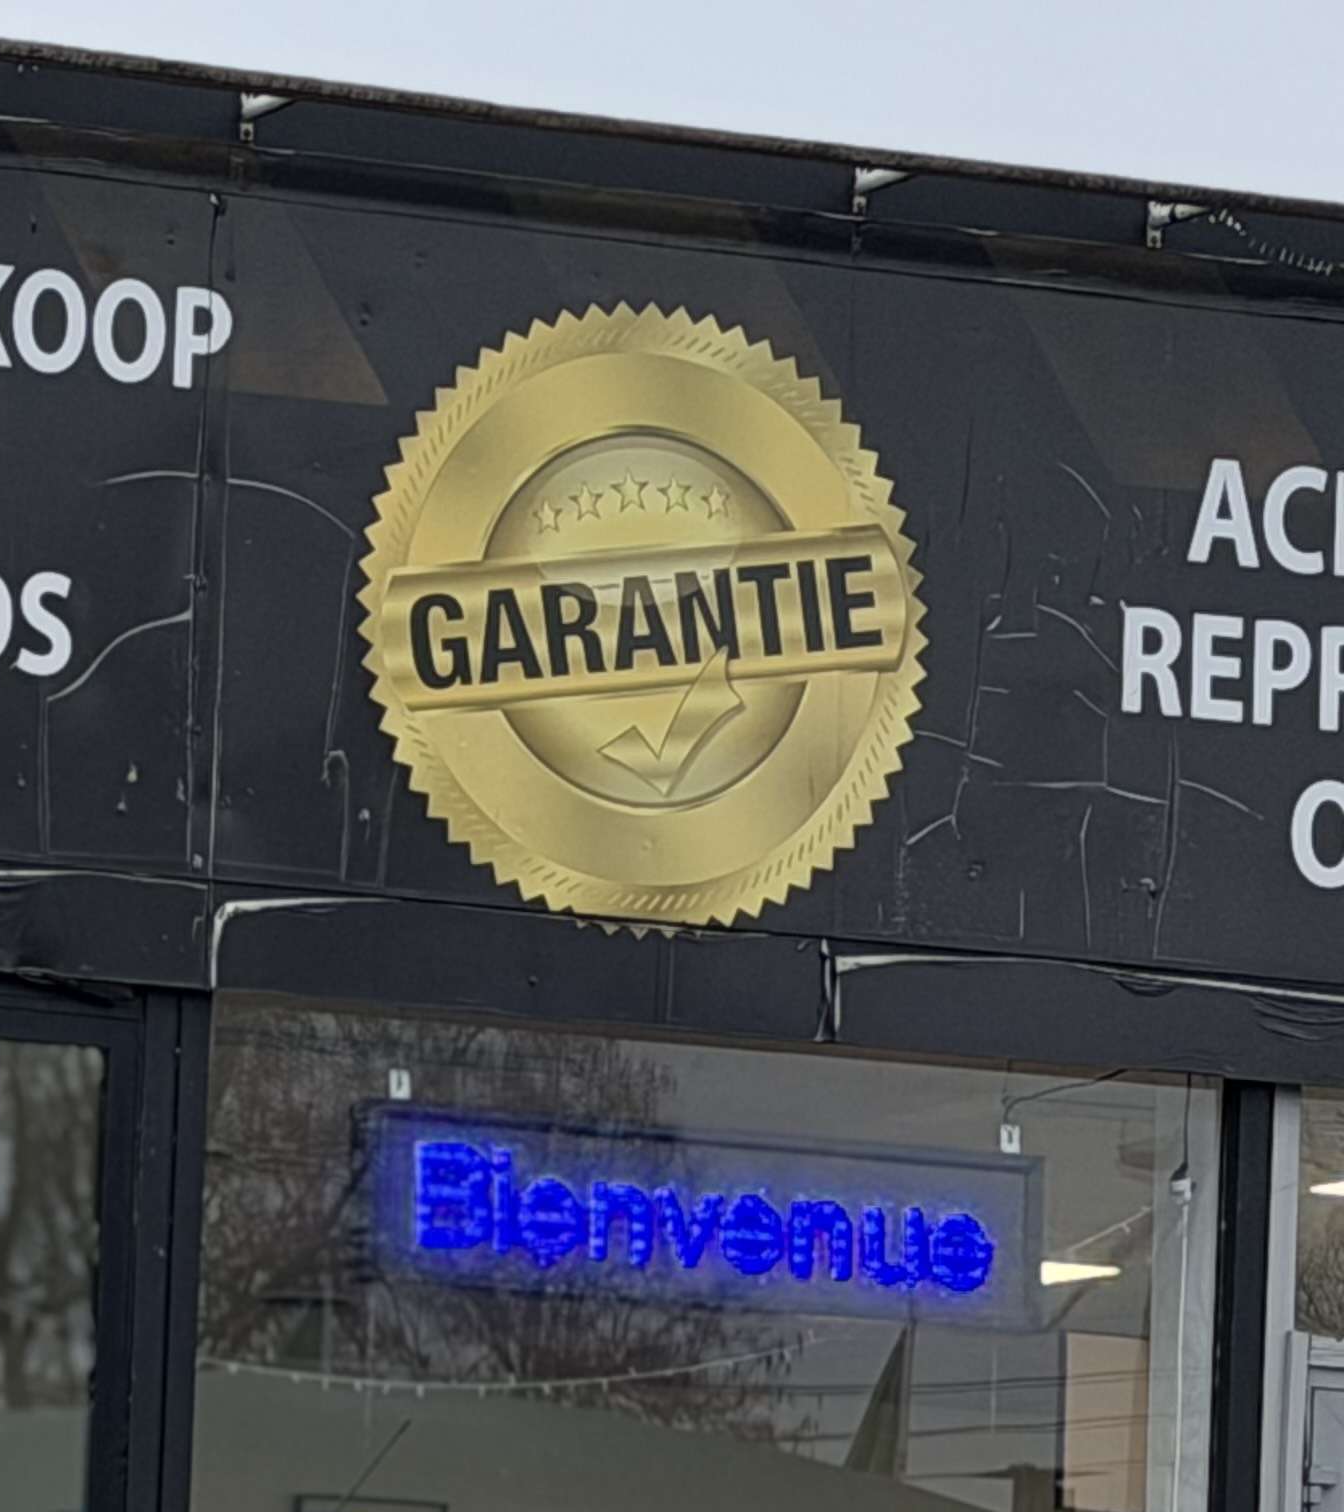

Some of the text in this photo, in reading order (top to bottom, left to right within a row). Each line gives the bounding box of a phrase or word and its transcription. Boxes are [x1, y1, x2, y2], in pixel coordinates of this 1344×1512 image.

[1187, 458, 1344, 577] AC
[409, 554, 885, 690] GARANTIE
[415, 1141, 994, 1291] Bienvenue
